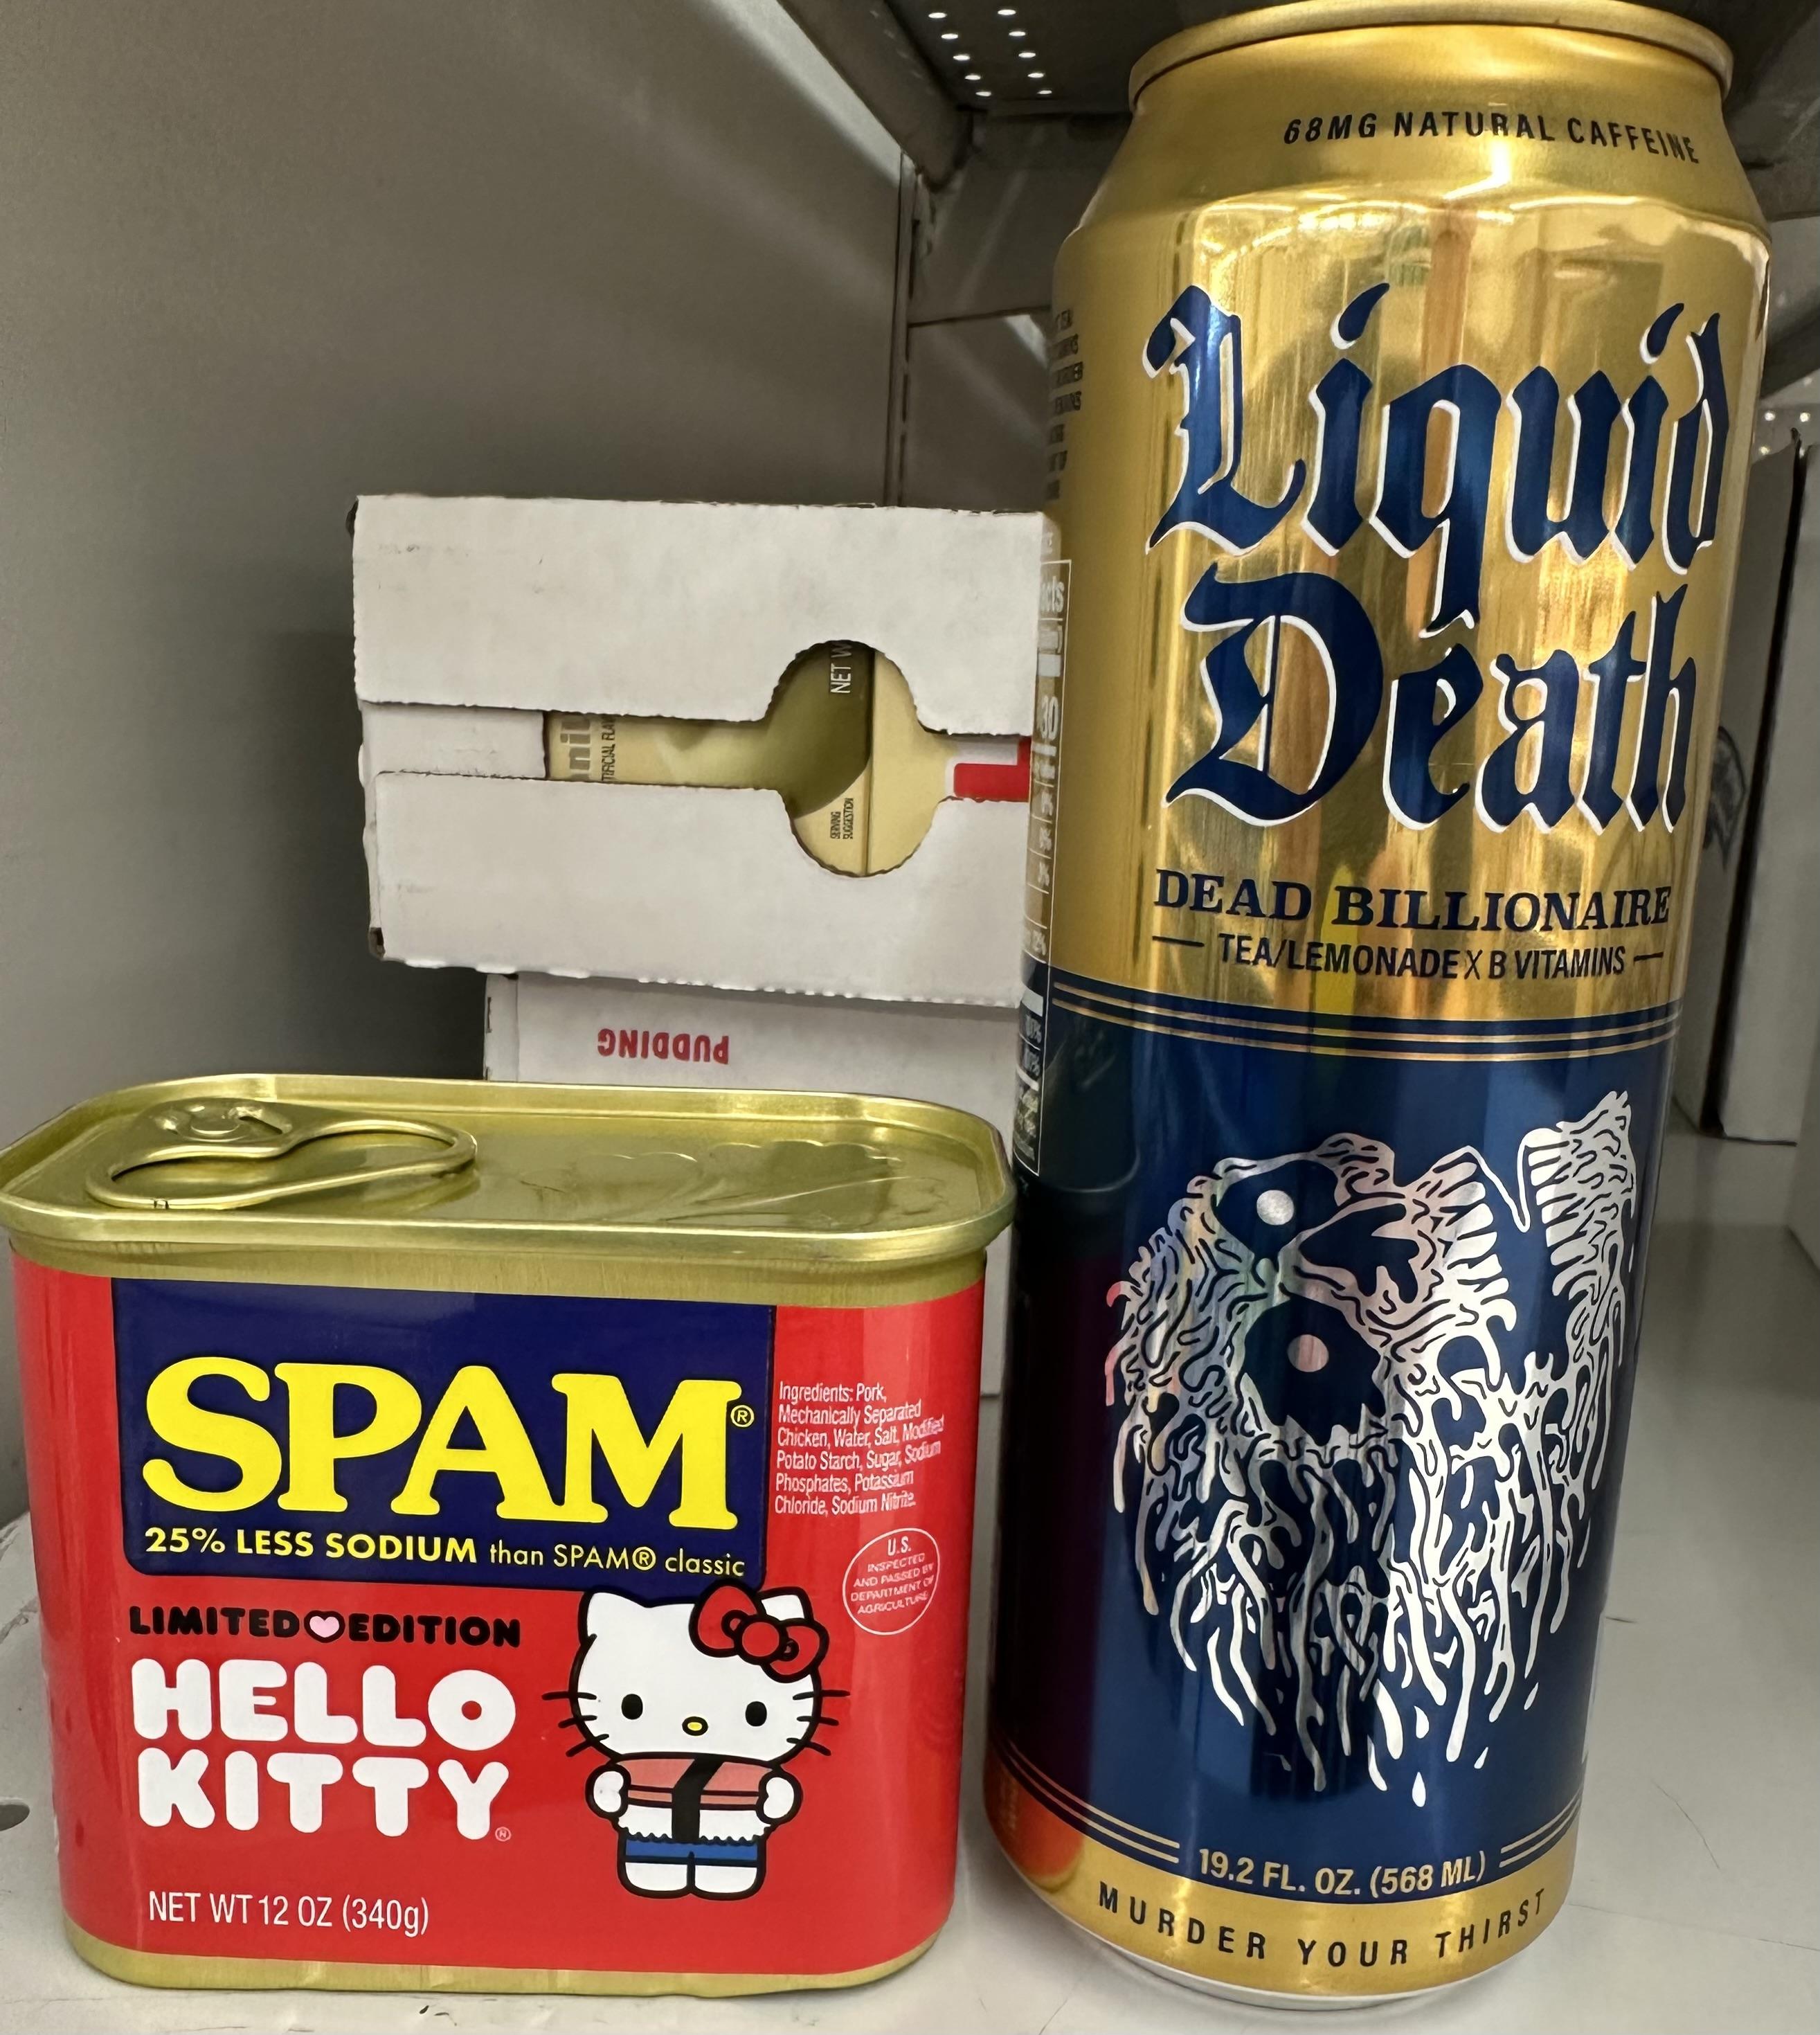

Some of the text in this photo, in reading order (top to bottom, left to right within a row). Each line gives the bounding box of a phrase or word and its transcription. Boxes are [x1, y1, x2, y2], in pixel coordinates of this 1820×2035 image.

[1284, 111, 1700, 164] 68MG NATURAL CAFFEINE
[1142, 283, 1729, 638] Liquid
[830, 663, 852, 693] NET
[1162, 562, 1697, 836] Death
[1153, 868, 1671, 932] DEAD BILLIONAIRE
[1218, 933, 1625, 980] TEA/LEMONADE X B VITAMINS
[597, 1028, 729, 1064] PUDDING
[779, 1381, 887, 1405] Ingredients: Pork,
[778, 1399, 921, 1428] Mechanically Separated
[777, 1428, 830, 1449] Chicken,
[833, 1428, 871, 1449] Water,
[903, 1415, 944, 1442] Modified
[776, 1440, 941, 1473] Potato Starch, Sugar, Sodium
[775, 1470, 914, 1495] Phosphates, Potassium
[775, 1494, 828, 1517] Chloride,
[831, 1491, 877, 1514] Sodium
[145, 1527, 226, 1554] 25%
[237, 1530, 314, 1558] LESS
[325, 1533, 476, 1563] SODIUM
[489, 1540, 544, 1566] than
[665, 1552, 746, 1578] classic
[867, 1552, 926, 1572] INSPECTED
[887, 1536, 912, 1556] U.S.
[851, 1575, 935, 1602] DEPARTMENT OF
[853, 1563, 934, 1588] AND PASSED BY
[857, 1591, 929, 1614] AGRICULTURE
[129, 1606, 521, 1647] LIMITED EDITION
[132, 1658, 516, 1751] HELLO
[1199, 1848, 1486, 1899] 19.2 FL. OZ. (568 ML)
[149, 1891, 429, 1937] NET WT 12 OZ (340g)
[1099, 1881, 1545, 1967] MURDER YOUR THIRST
